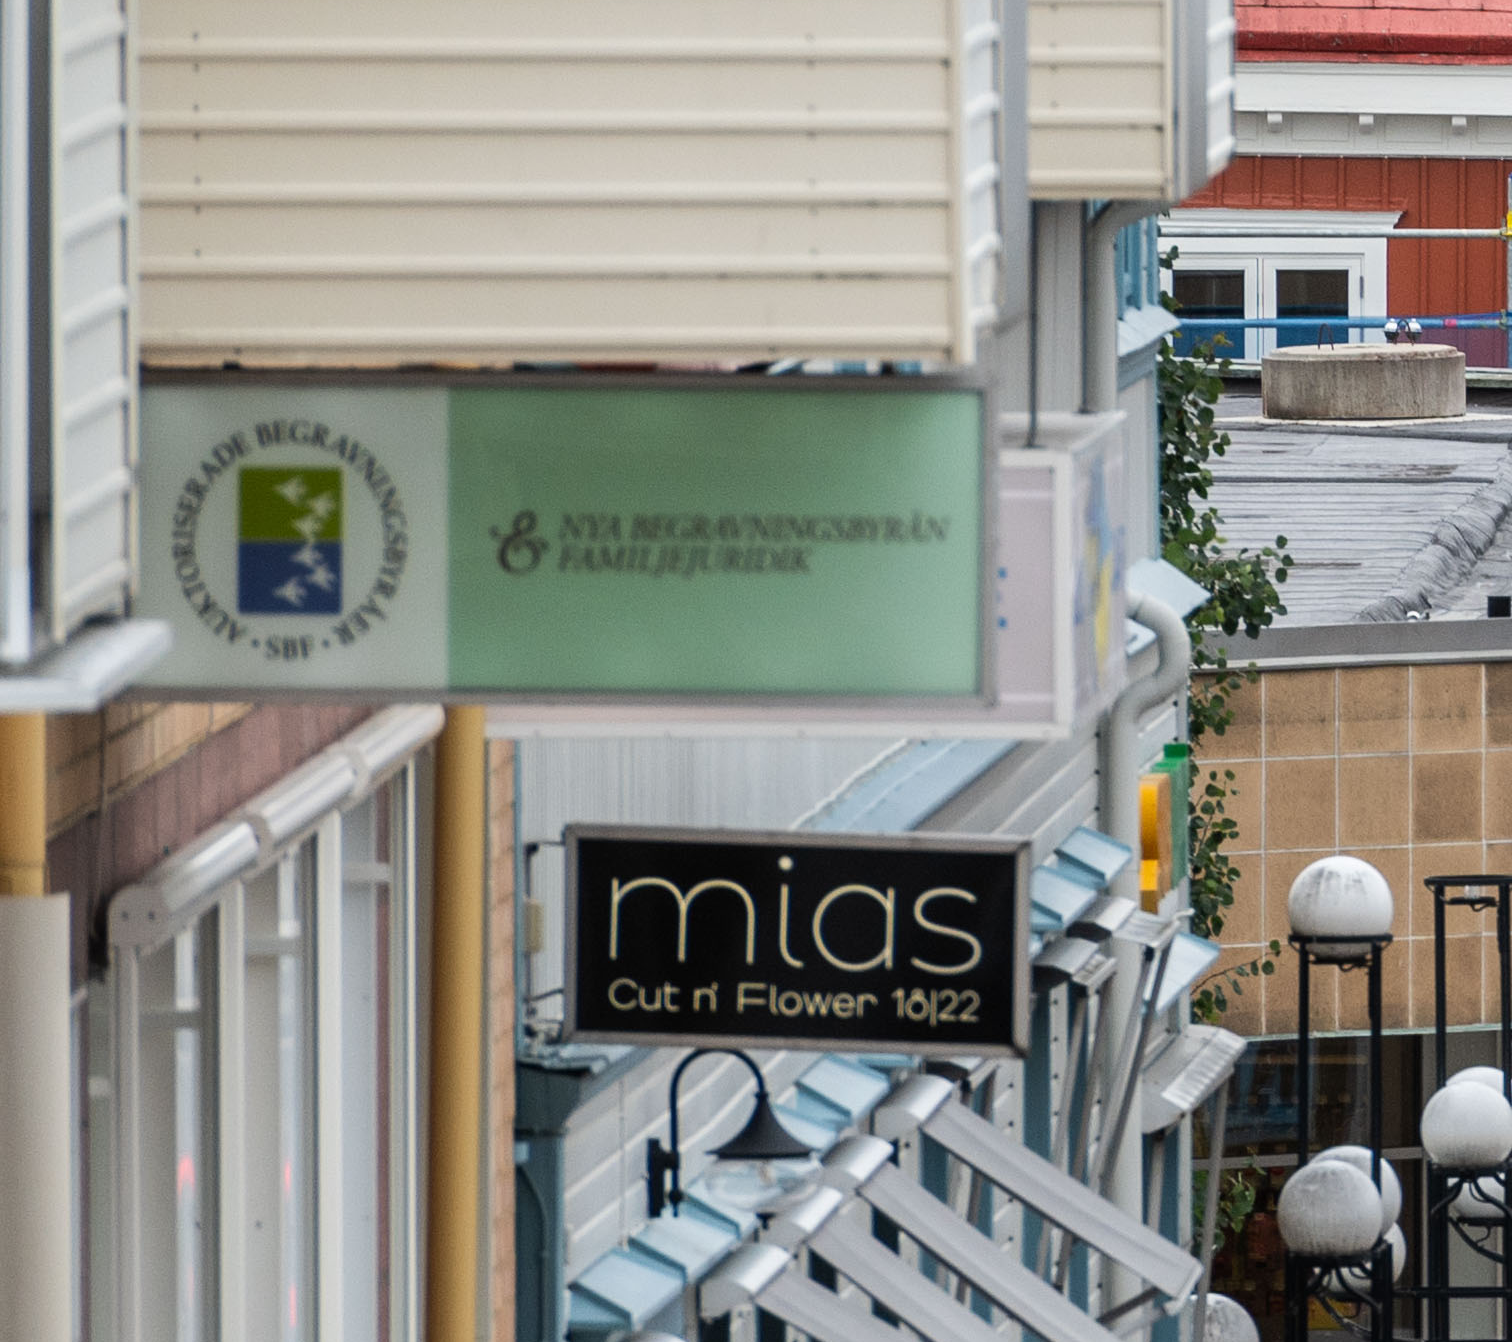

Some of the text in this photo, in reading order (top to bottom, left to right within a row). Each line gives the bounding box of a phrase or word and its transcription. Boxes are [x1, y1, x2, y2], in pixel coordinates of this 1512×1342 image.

[171, 430, 250, 645] AUKTORISERADE
[265, 634, 313, 661] SBF
[609, 855, 982, 976] mias
[608, 977, 681, 1012] Cut
[736, 982, 879, 1017] Flower
